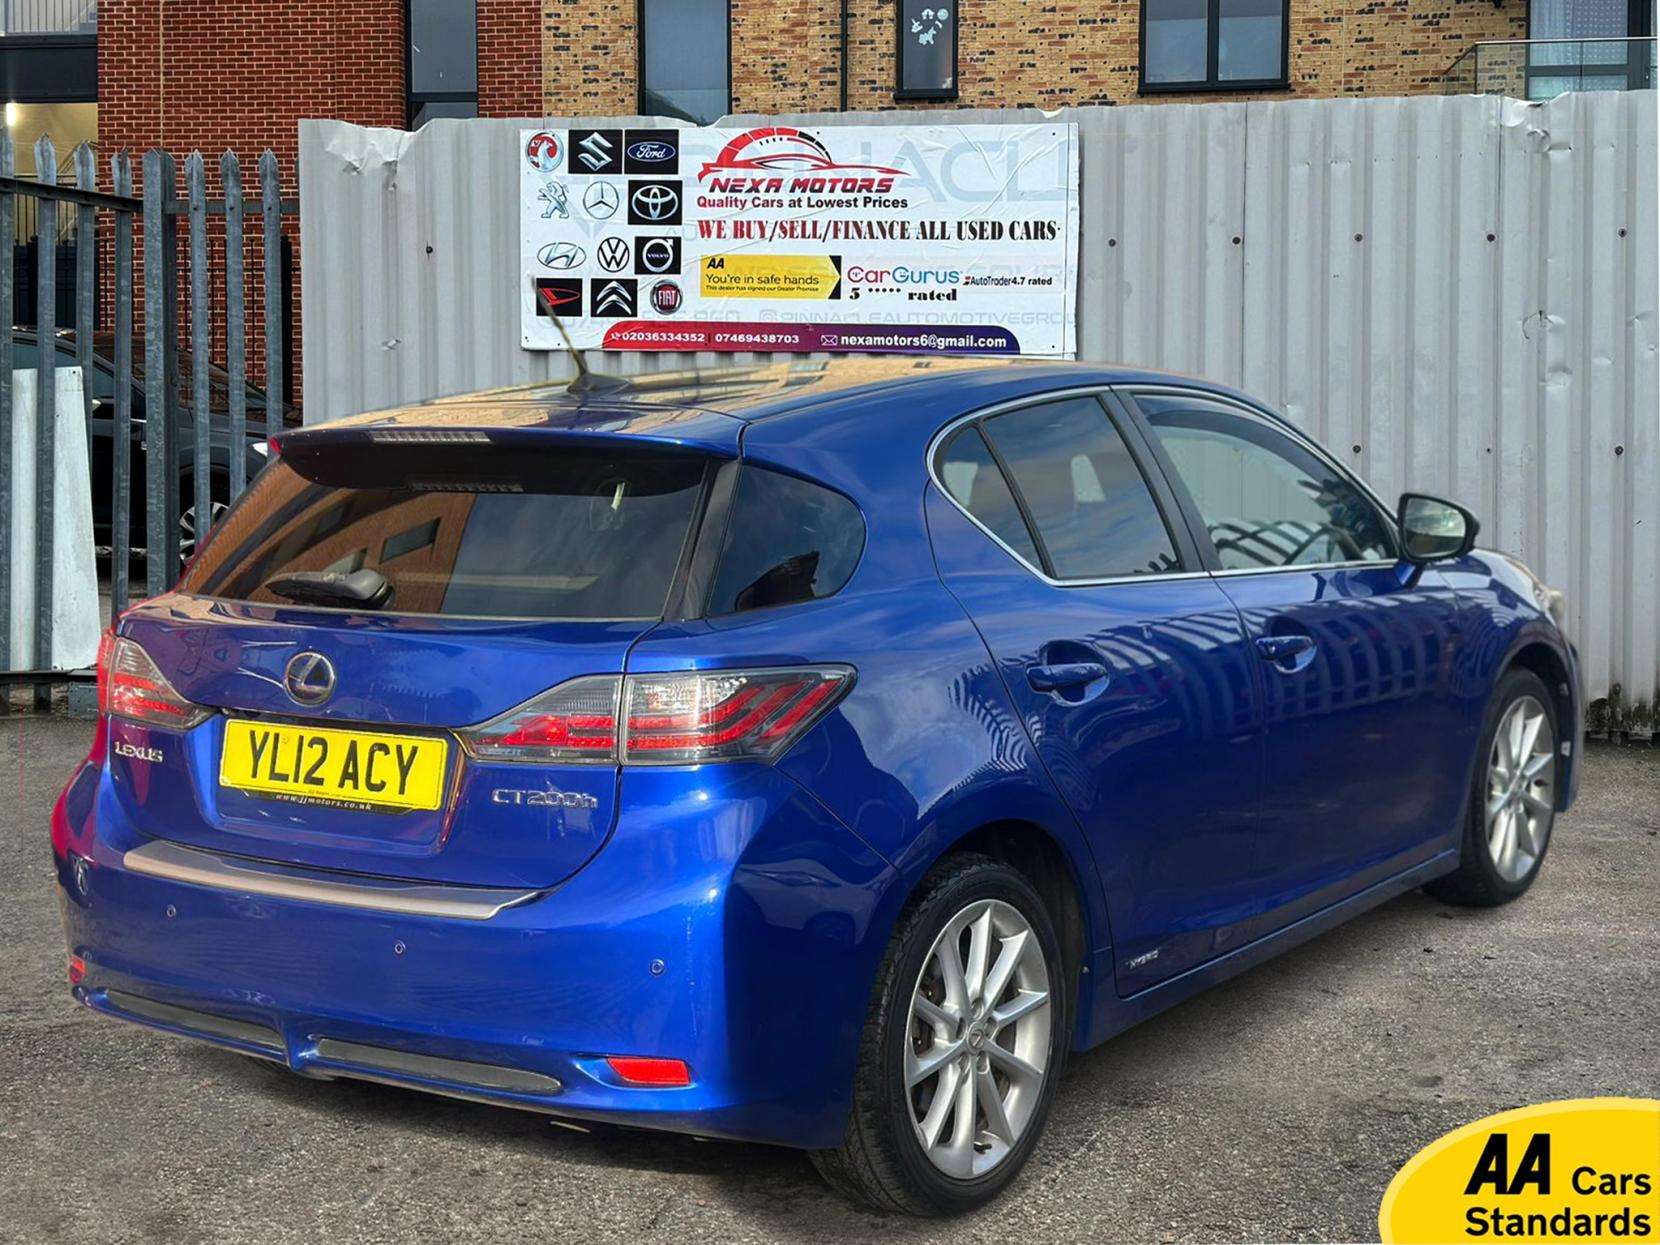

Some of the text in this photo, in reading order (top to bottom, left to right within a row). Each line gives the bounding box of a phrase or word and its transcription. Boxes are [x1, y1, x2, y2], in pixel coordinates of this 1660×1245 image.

[636, 144, 666, 158] Ford
[709, 178, 895, 193] NEXA MOTORS
[697, 196, 908, 210] Quality Cars at Lowest Prices
[698, 220, 727, 240] WE
[916, 221, 951, 240] ALL
[956, 221, 1004, 240] USED
[1009, 221, 1057, 240] CARS
[707, 258, 725, 269] AA
[706, 273, 820, 285] You're in safe hands
[847, 266, 960, 284] CarGurus
[1028, 277, 1053, 286] rated
[658, 290, 677, 305] FIAT
[849, 287, 957, 301] 5 rated
[622, 332, 799, 343] 02036334352 07469438703
[841, 334, 1007, 349] nexamotors6@gmail.com
[115, 741, 163, 763] LEXUS
[249, 730, 419, 796] YL12 ACY
[275, 793, 372, 811] www.jjmotors.co.uk
